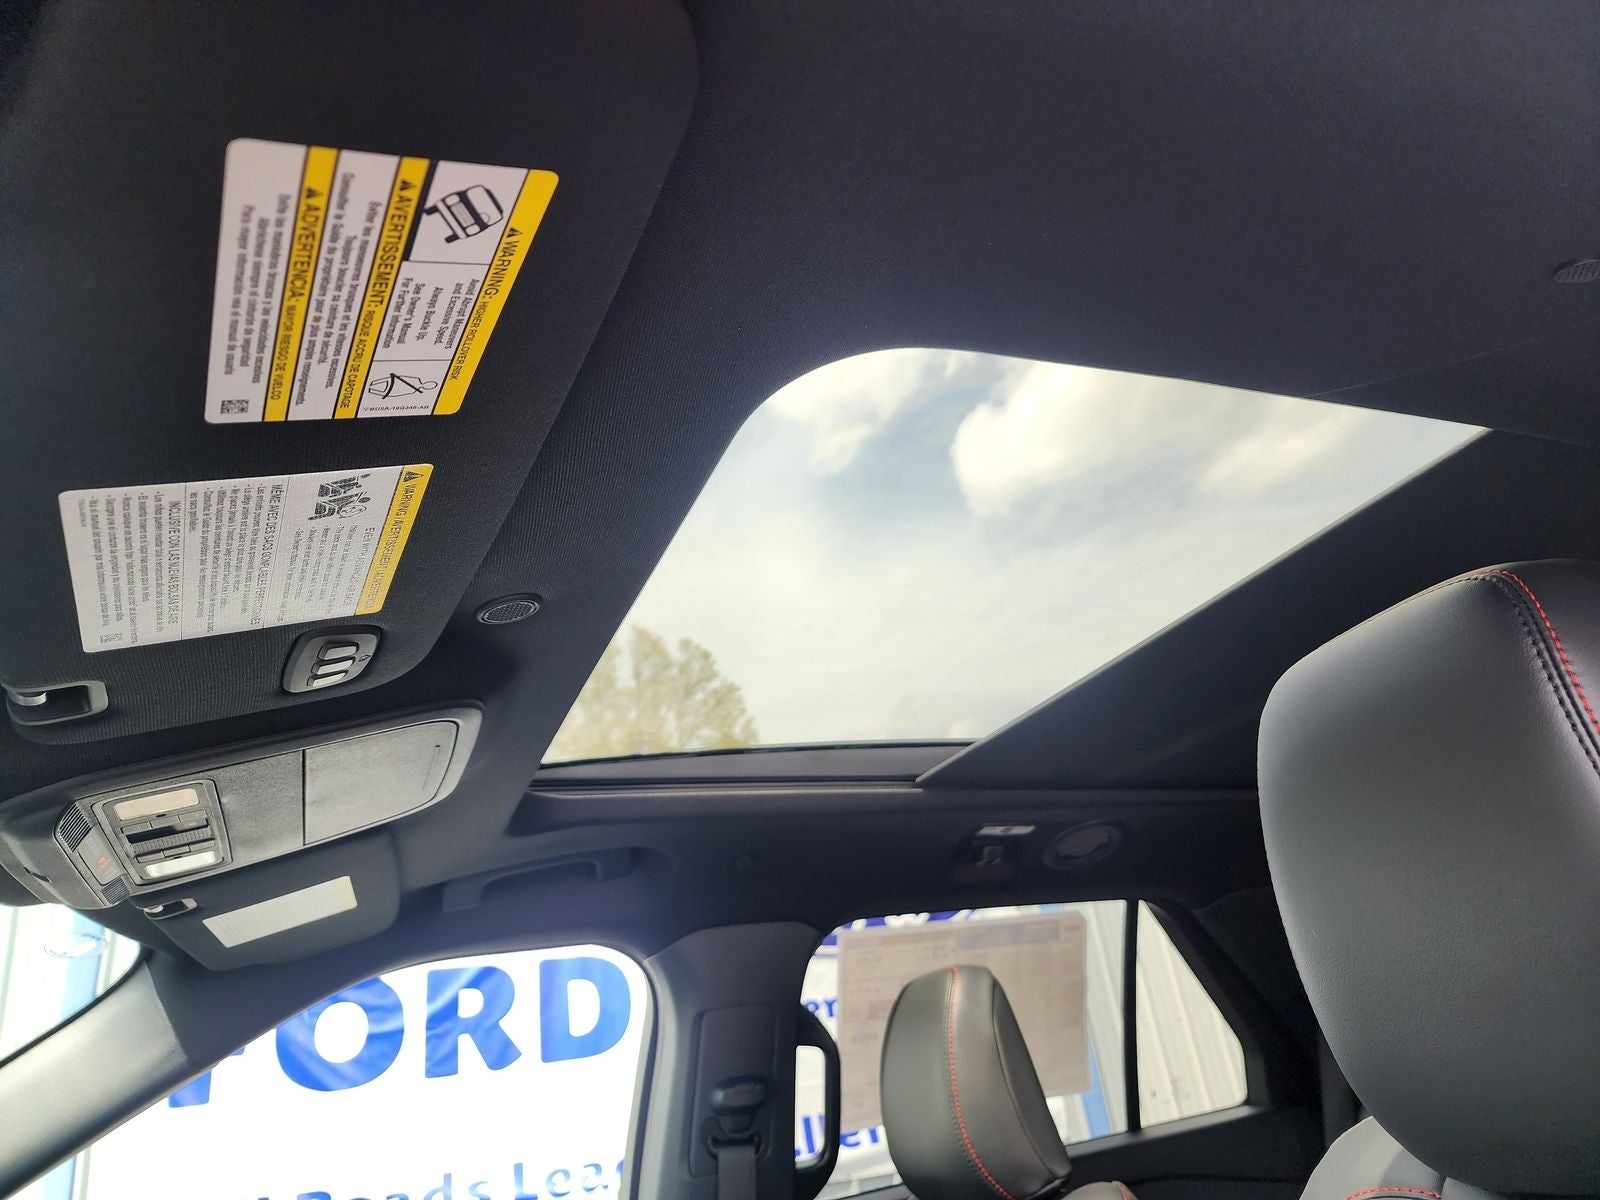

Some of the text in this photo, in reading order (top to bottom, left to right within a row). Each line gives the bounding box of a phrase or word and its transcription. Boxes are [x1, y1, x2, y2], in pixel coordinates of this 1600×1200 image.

[287, 203, 321, 302] ADVERTENCIA:
[400, 277, 413, 287] For
[339, 196, 413, 408] AVERTISSEMENT: RISQUE ACCRU DE CAPOTAGE
[392, 290, 409, 312] Further
[396, 283, 425, 344] See Owner's Manual
[414, 286, 444, 340] Always Buckle Up.
[432, 282, 464, 345] and Excessive Speed.
[444, 278, 480, 348] Avoid Abrupt Maneuvers
[448, 240, 519, 380] WARNING: HIGHER ROLLOVER RISK
[268, 484, 286, 503] MÊME
[395, 483, 416, 515] WARNING
[168, 500, 180, 534] INCLUSIVE
[266, 504, 281, 520] AVEC
[168, 534, 179, 548] CON
[264, 521, 278, 534] DES
[168, 548, 179, 560] LAS
[262, 534, 276, 551] SACS
[168, 561, 179, 582] NUEVAS
[168, 583, 178, 604] BOLSAS
[513, 1157, 624, 1200] Lea
